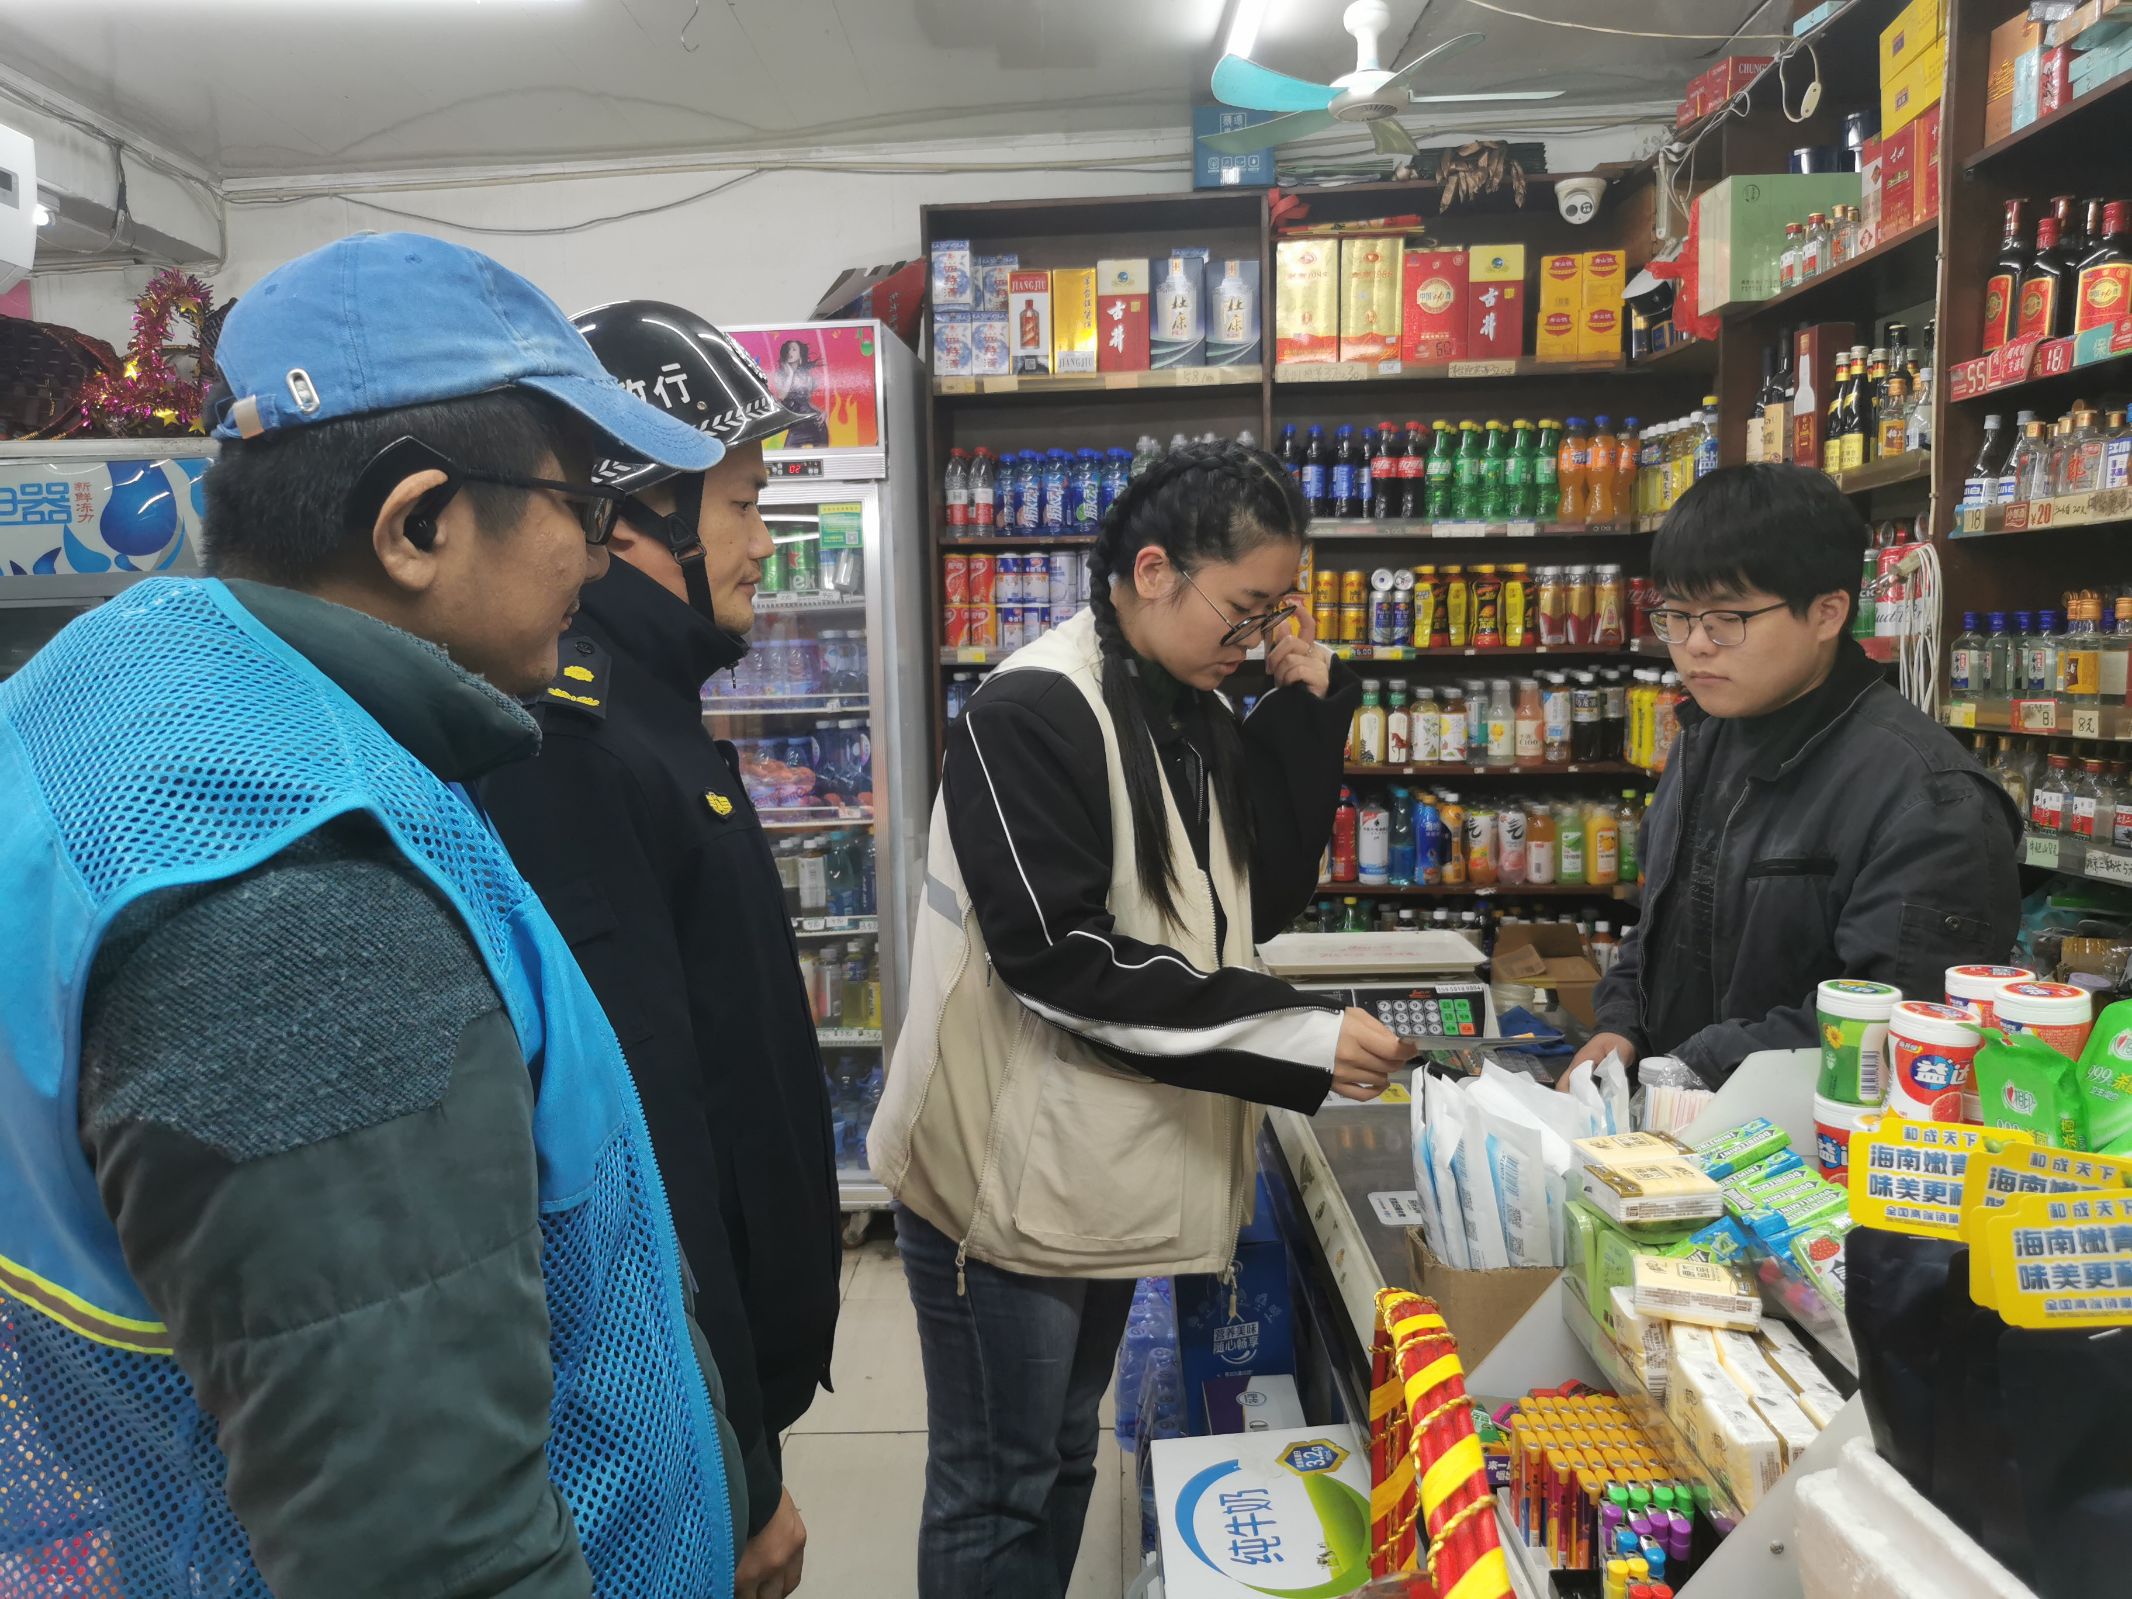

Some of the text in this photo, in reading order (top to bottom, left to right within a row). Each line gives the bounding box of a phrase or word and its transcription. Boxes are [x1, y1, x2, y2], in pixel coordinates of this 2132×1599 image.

[1011, 279, 1047, 293] JIANGJIU
[1107, 299, 1127, 354] 古井
[1170, 294, 1189, 330] 杜康
[1226, 296, 1244, 332] 杜康
[1478, 286, 1500, 342] 古井
[73, 481, 95, 524] 新鲜冻力
[1914, 1057, 1971, 1086] 益达
[1903, 1126, 1978, 1147] 和成天下
[2030, 1152, 2115, 1180] 和成天下
[1213, 1321, 1259, 1341] 营养美味
[1213, 1336, 1259, 1355] 随心畅享
[1218, 1488, 1285, 1565] 纯牛奶
